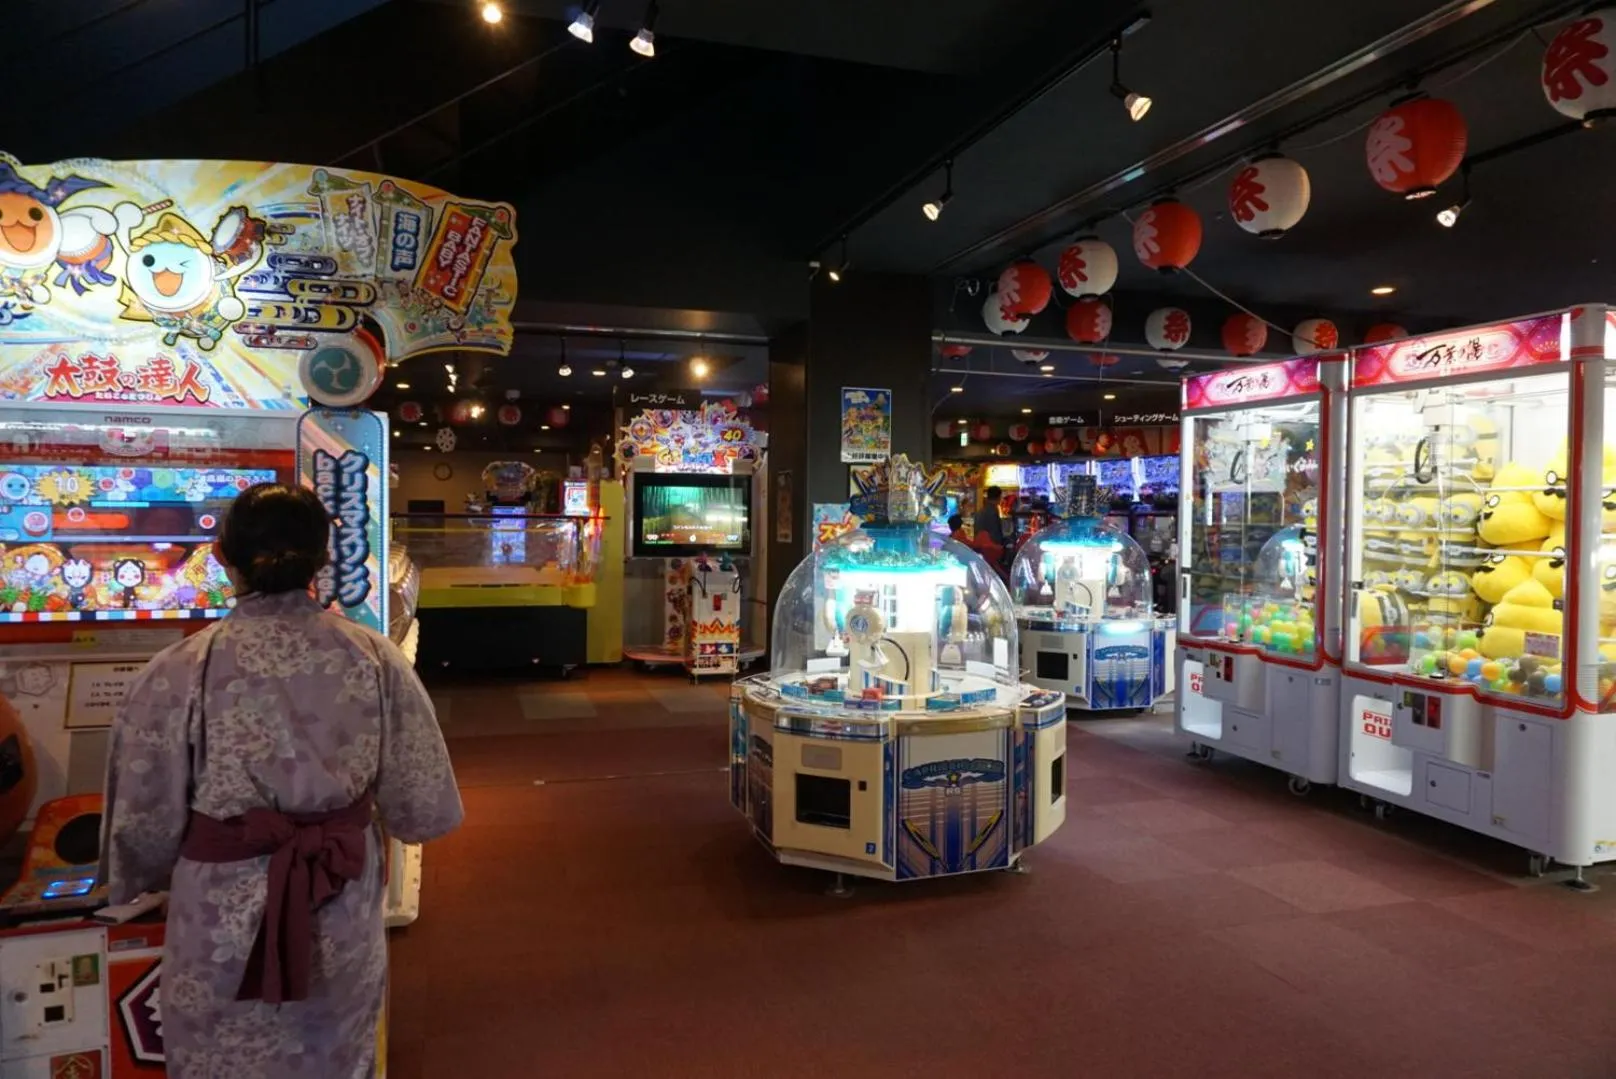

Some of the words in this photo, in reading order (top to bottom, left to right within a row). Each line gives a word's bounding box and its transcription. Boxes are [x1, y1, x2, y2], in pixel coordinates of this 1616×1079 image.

[437, 230, 463, 268] BABY
[442, 216, 488, 297] FANTASTIC
[45, 353, 209, 403] 太鼓の達人
[630, 393, 686, 405] レースゲーム
[104, 415, 152, 425] namco
[1113, 412, 1179, 424] シューティングゲーム
[54, 475, 80, 494] 10
[338, 451, 368, 604] クリスマスソング
[1363, 722, 1392, 738] OU
